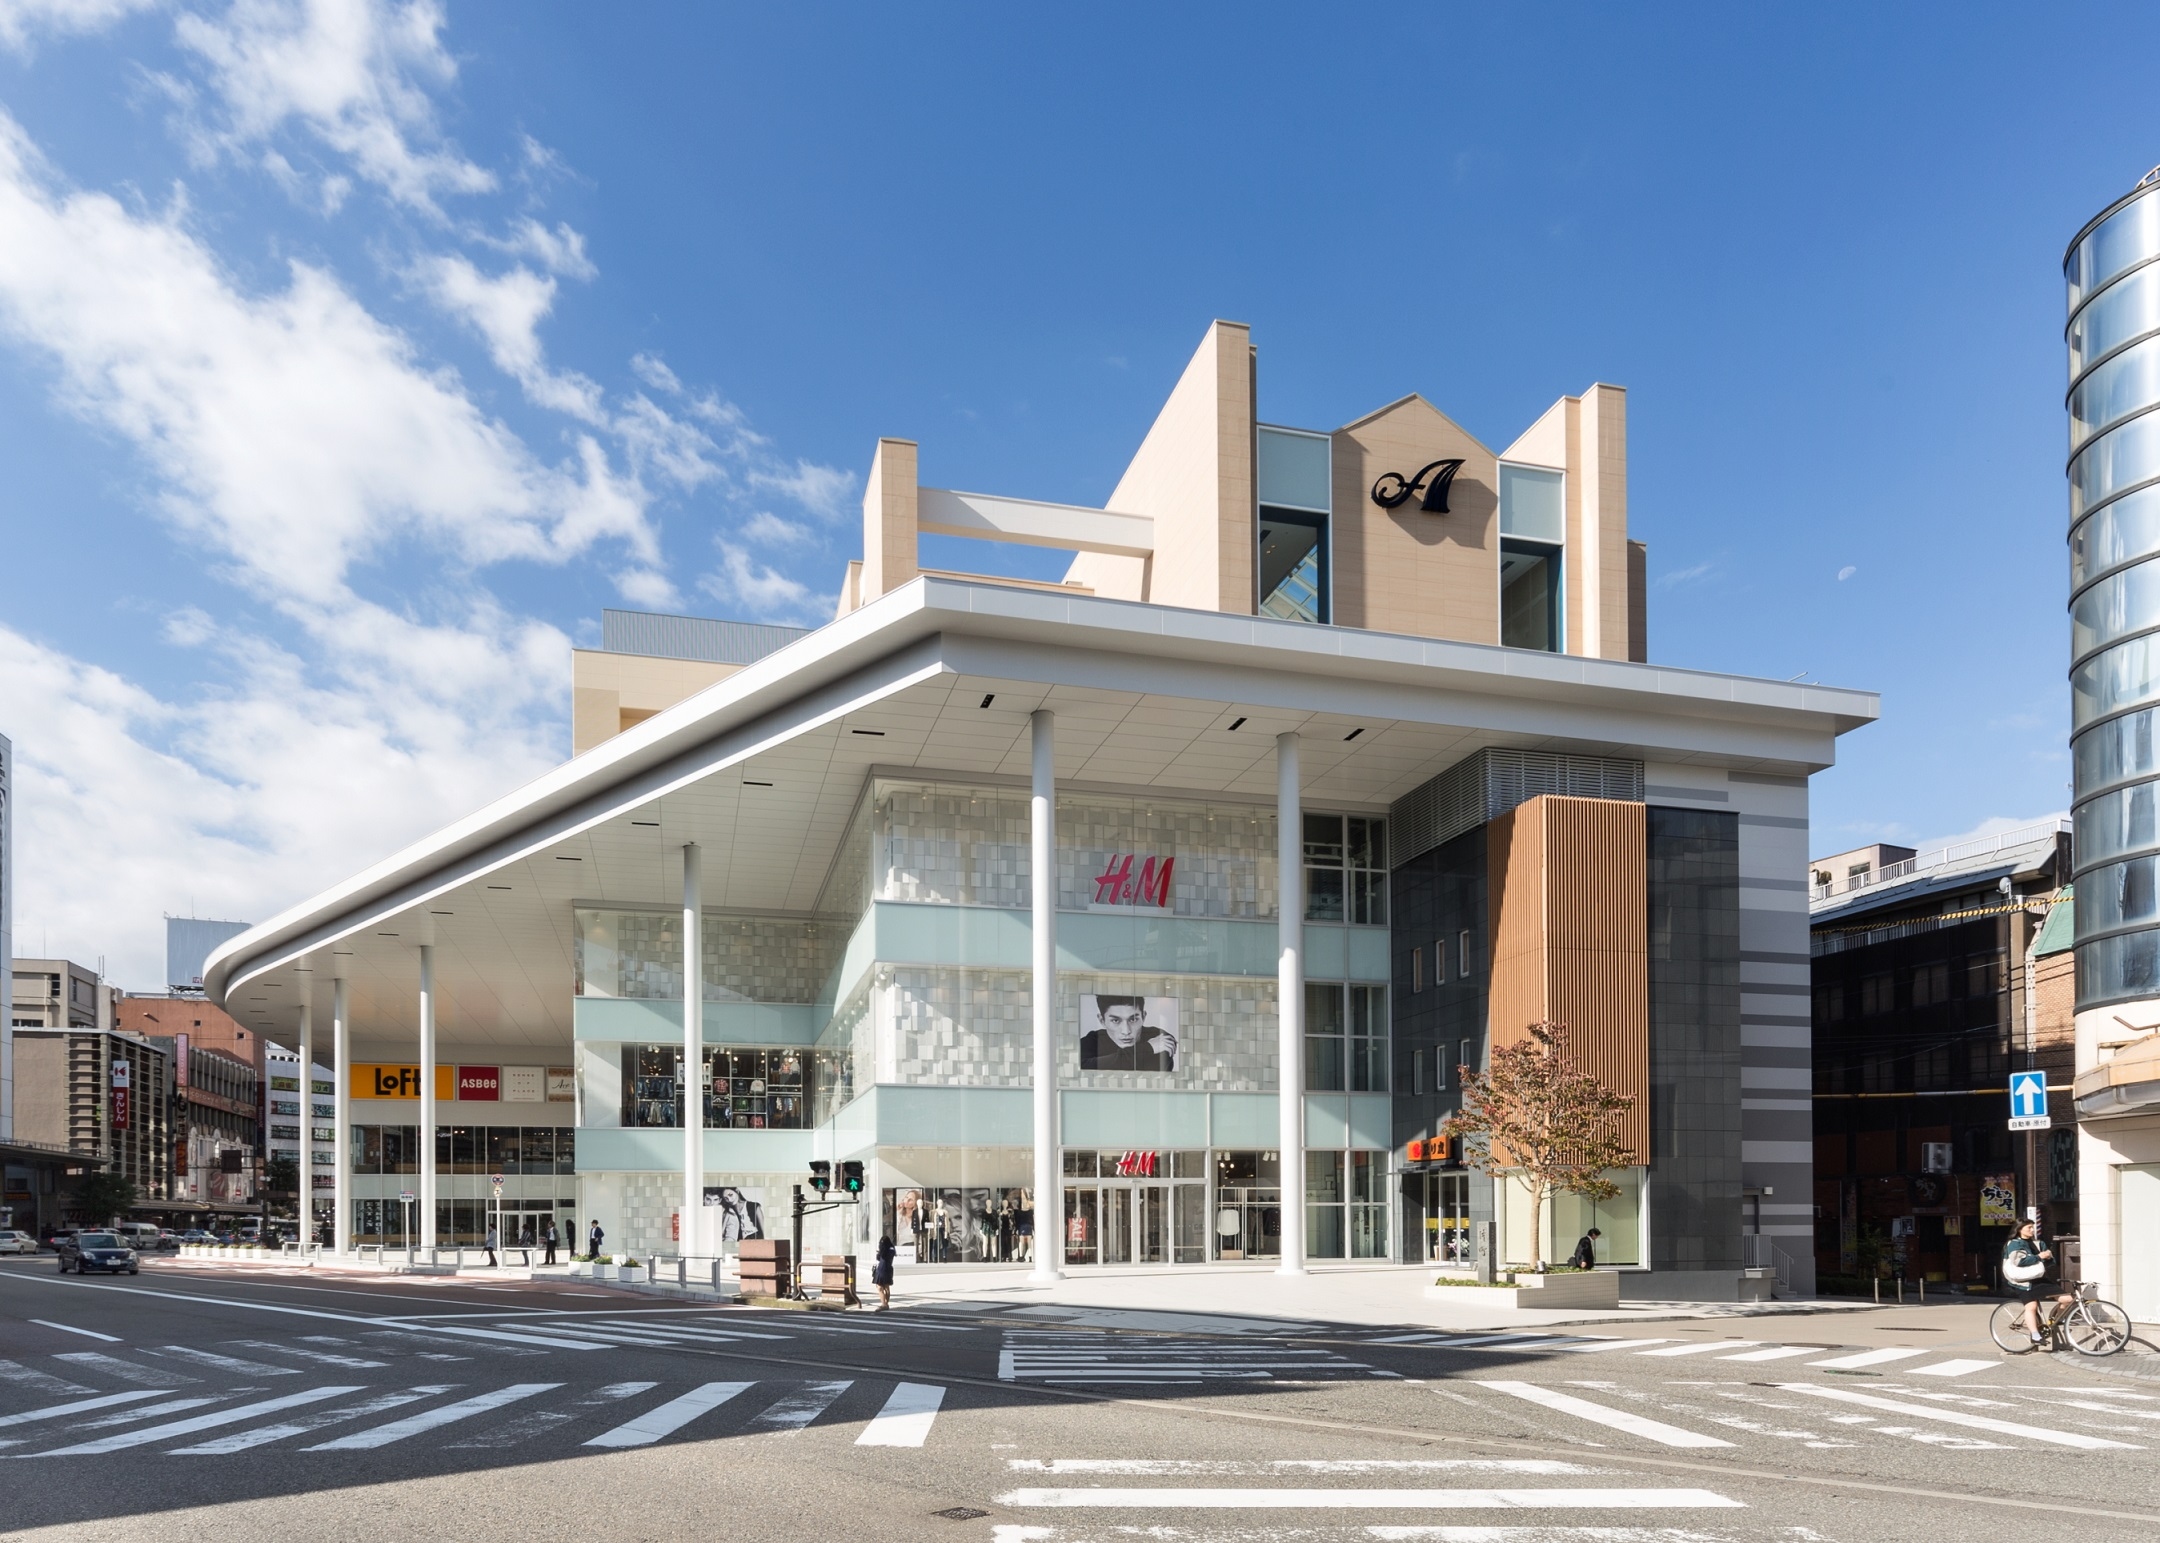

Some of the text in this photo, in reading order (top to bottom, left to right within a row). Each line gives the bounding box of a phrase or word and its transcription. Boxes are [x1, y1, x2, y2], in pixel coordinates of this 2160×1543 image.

[1094, 853, 1175, 908] H&M
[461, 1078, 497, 1089] ASBee
[1116, 1150, 1155, 1176] H&M
[1072, 1217, 1083, 1242] SALE
